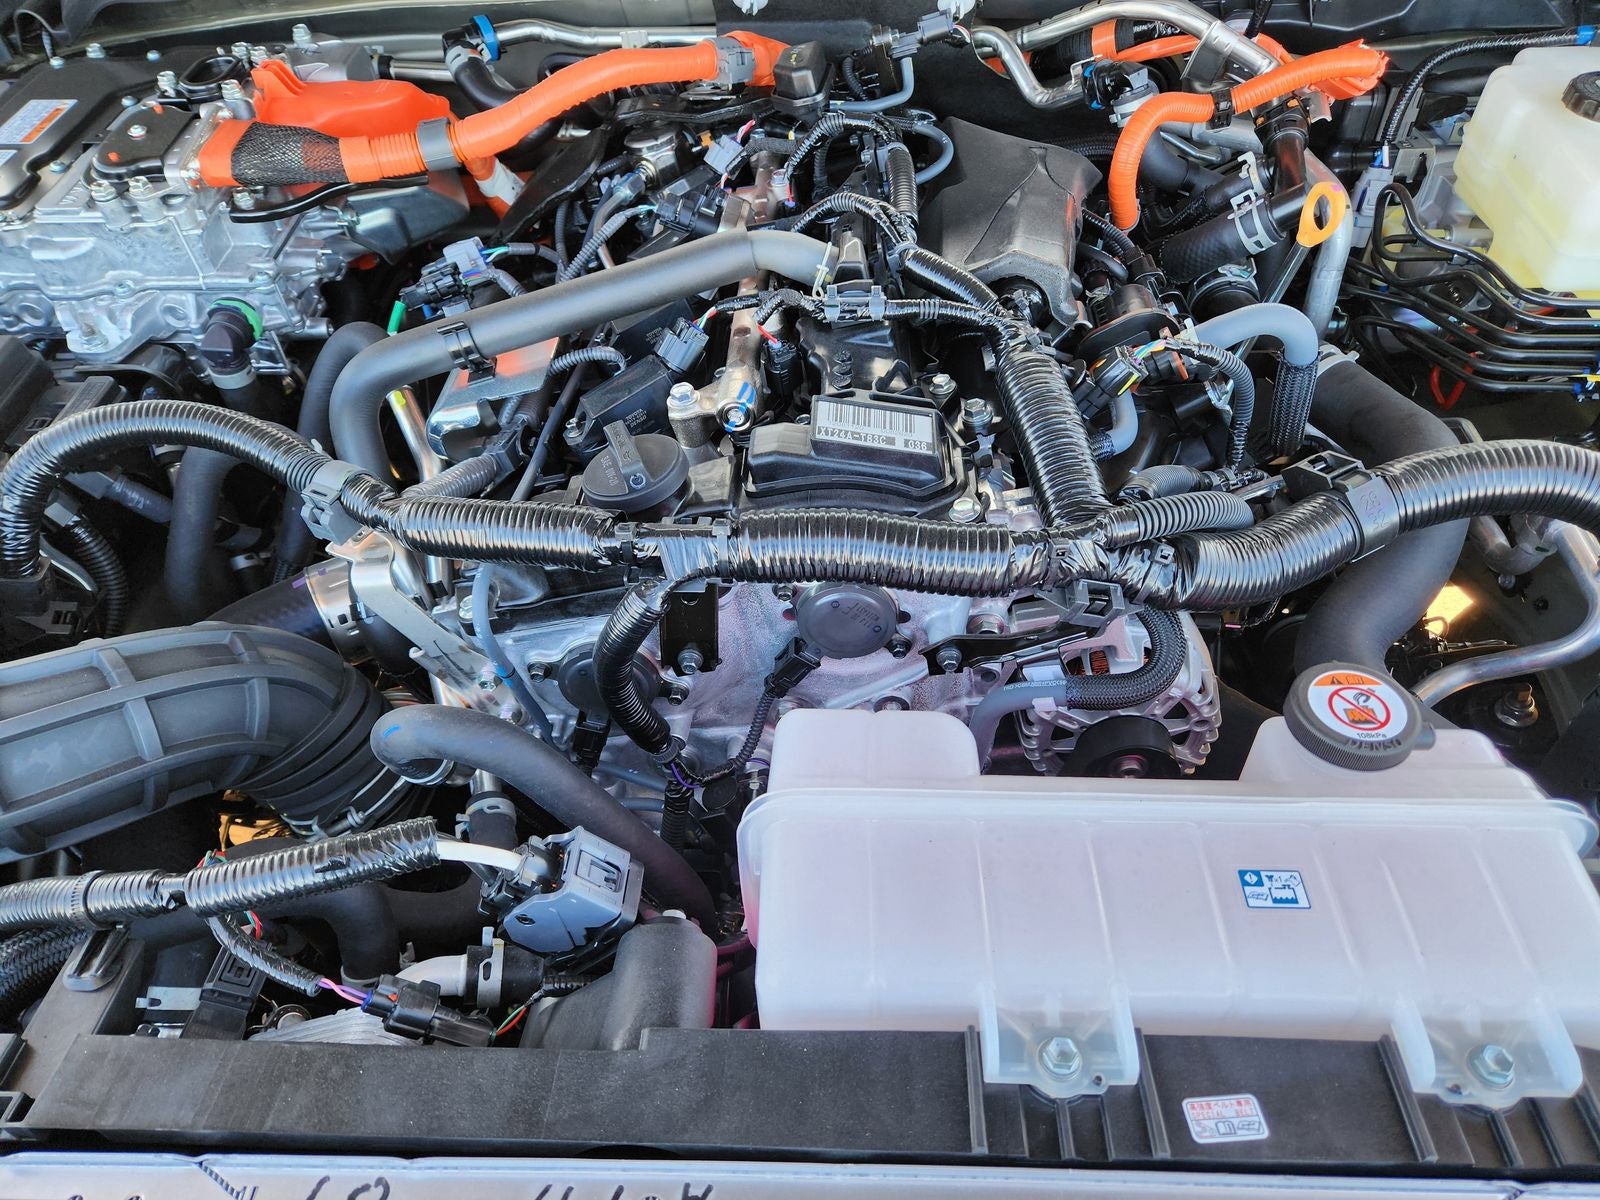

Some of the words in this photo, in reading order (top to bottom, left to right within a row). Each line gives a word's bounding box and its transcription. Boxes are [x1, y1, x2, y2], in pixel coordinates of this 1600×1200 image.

[625, 409, 643, 420] TOYOTA
[630, 415, 647, 428] DENSO
[908, 440, 928, 450] 036
[600, 455, 611, 468] SAE
[1356, 732, 1388, 740] 108kPa
[1348, 739, 1403, 752] DENSO
[1191, 1110, 1226, 1120] SPECIAL
[1235, 1108, 1258, 1117] BELT
